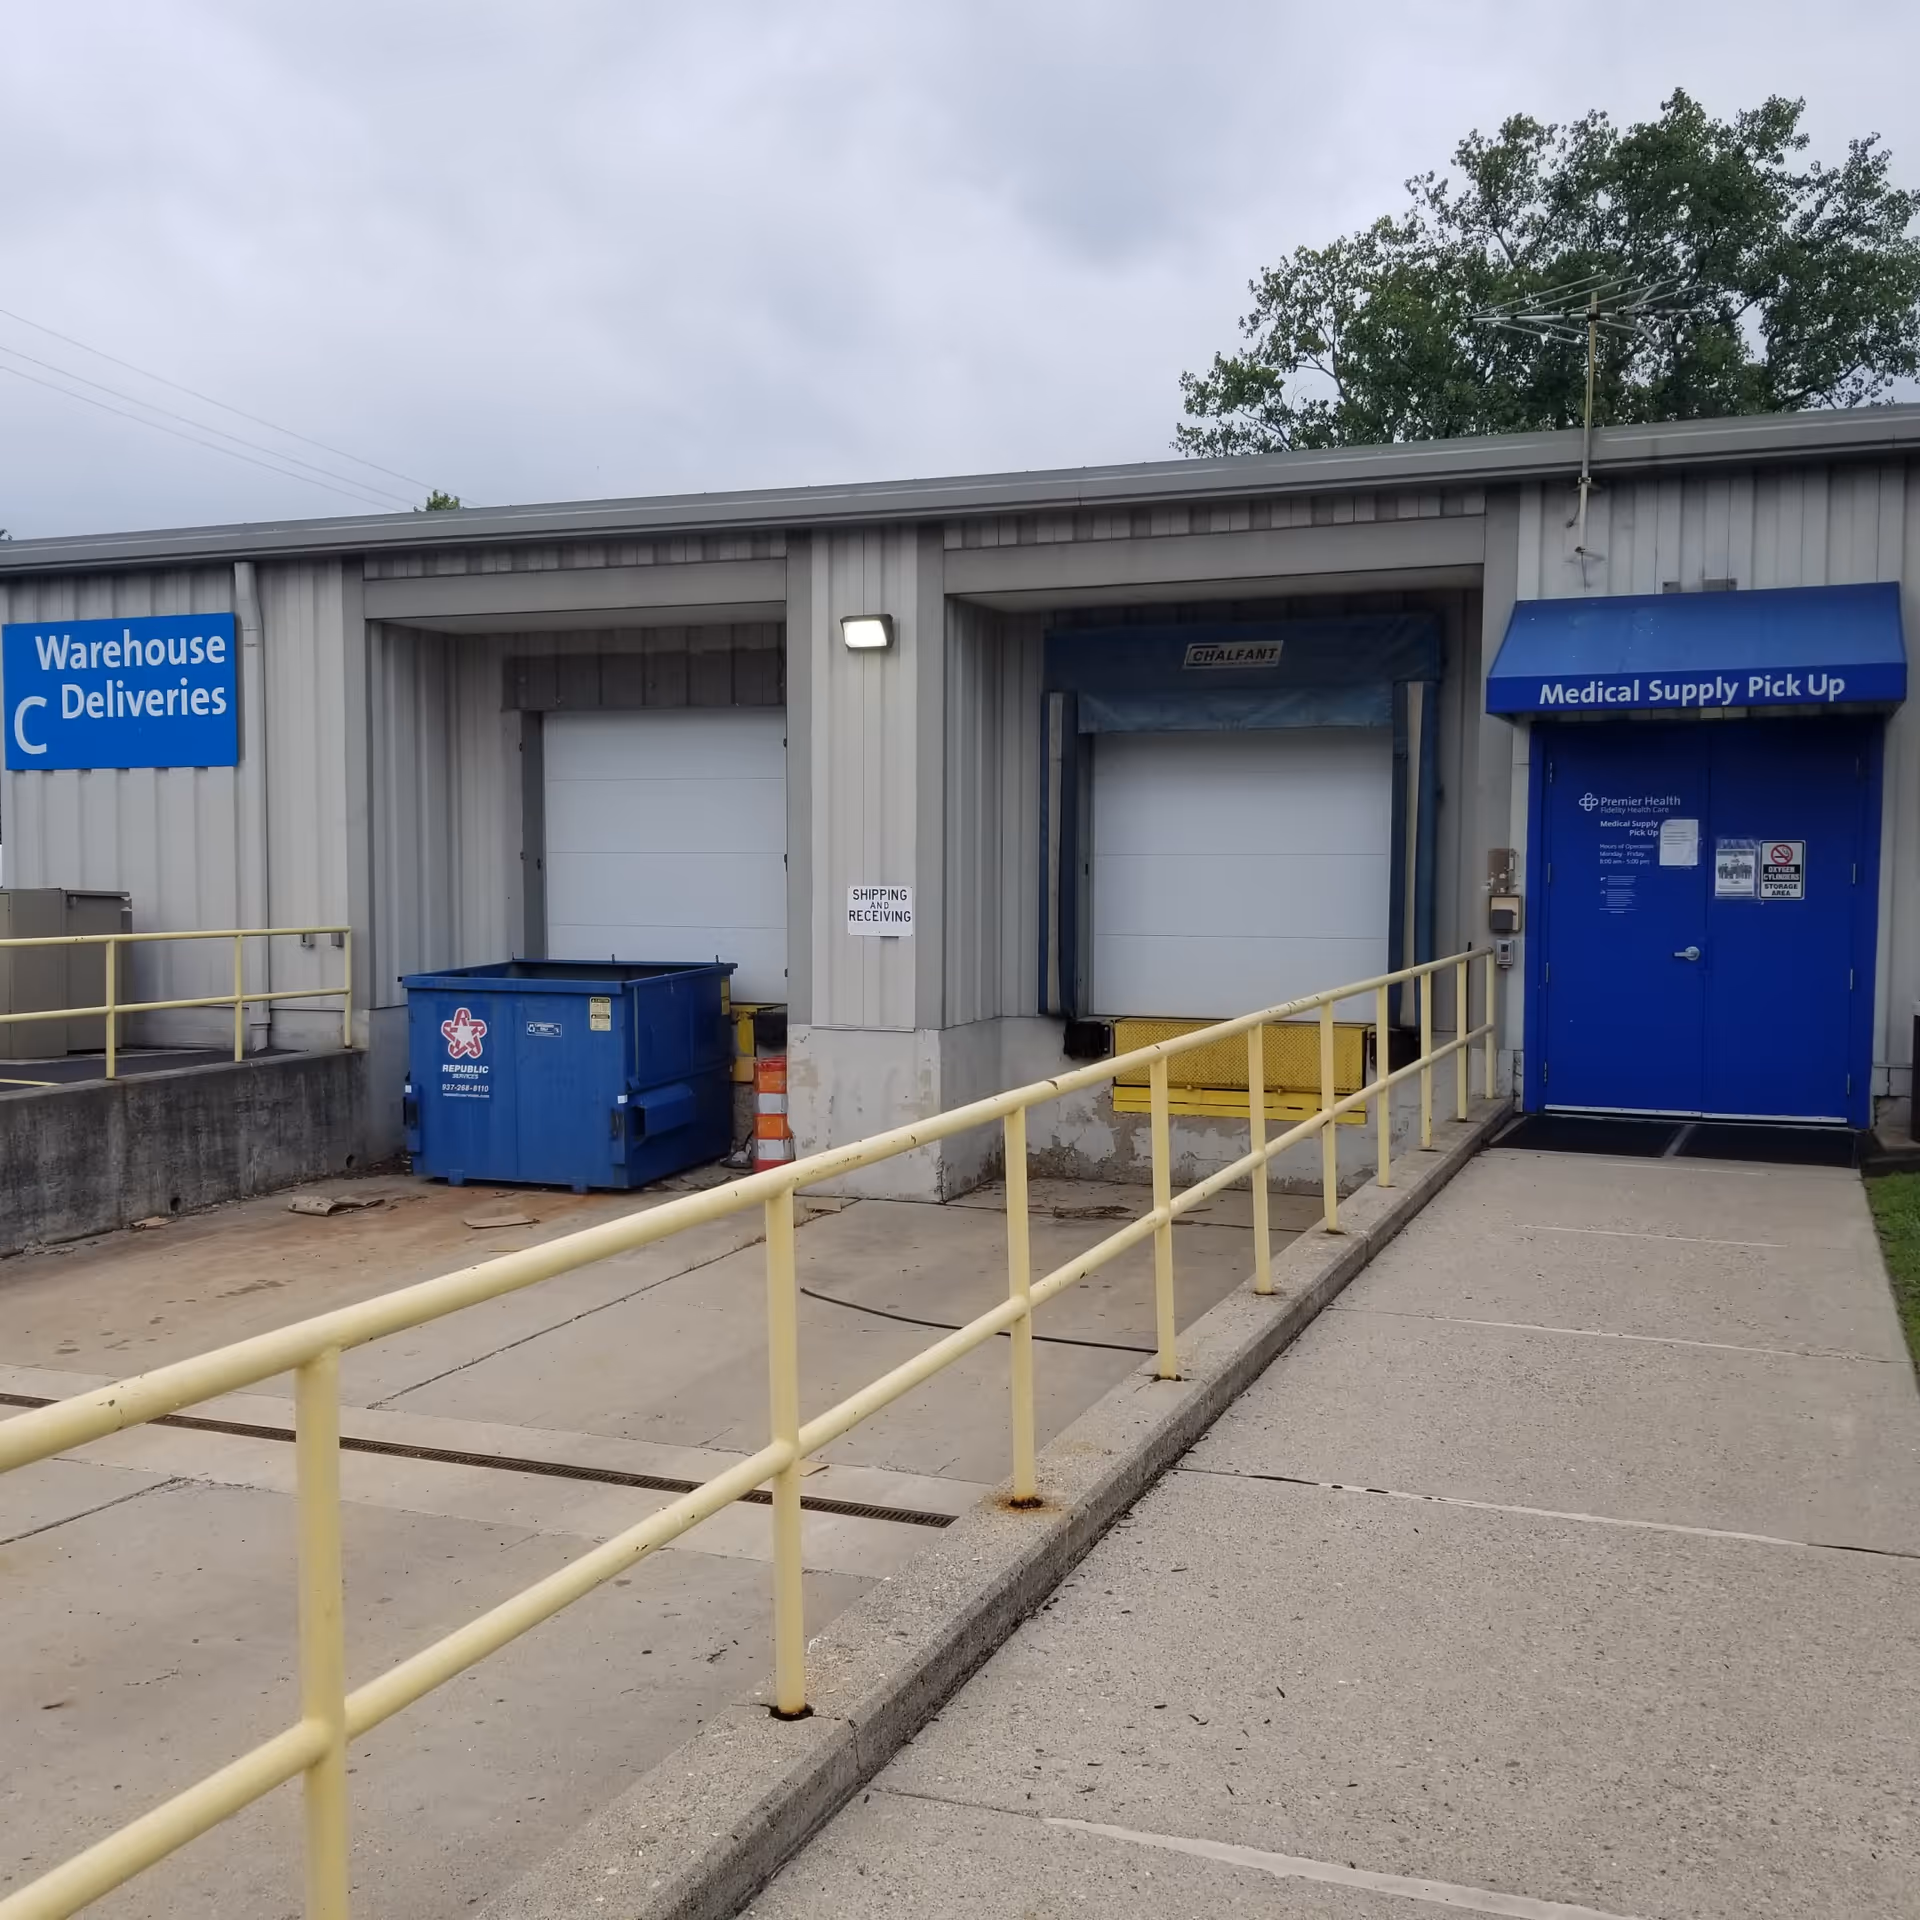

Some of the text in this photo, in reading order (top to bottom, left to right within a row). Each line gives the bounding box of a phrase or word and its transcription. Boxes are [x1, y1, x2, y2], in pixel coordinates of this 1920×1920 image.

[35, 628, 226, 671] Warehouse
[1193, 648, 1278, 662] CHALFANT
[1539, 673, 1845, 706] Medical Supply Pick Up
[61, 677, 227, 720] Deliveries
[14, 695, 47, 755] C
[1601, 796, 1681, 806] Premier Health
[1601, 806, 1625, 815] Fidelity
[1600, 820, 1659, 829] Medical Supply
[1629, 829, 1659, 837] Pick Up
[852, 888, 907, 901] SHIPPING
[869, 901, 890, 910] AND
[848, 909, 912, 922] RECEIVING
[442, 1064, 489, 1074] REPUBLIC
